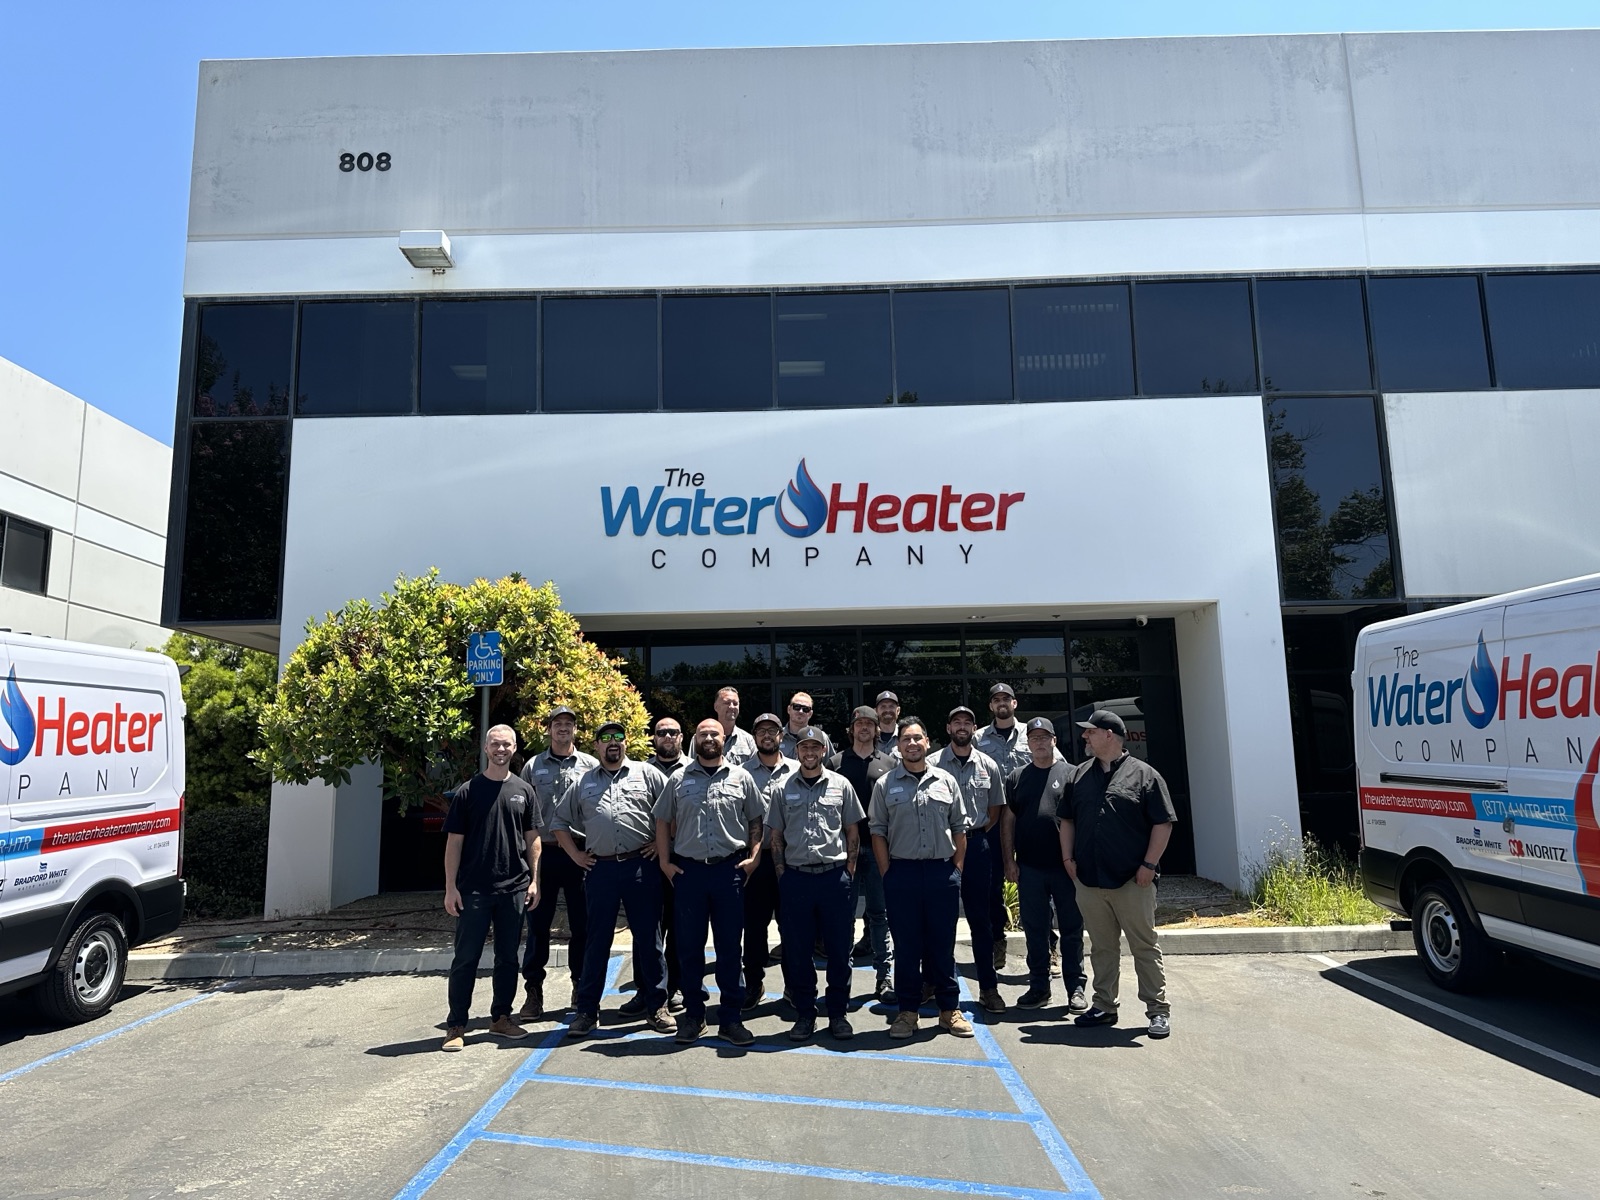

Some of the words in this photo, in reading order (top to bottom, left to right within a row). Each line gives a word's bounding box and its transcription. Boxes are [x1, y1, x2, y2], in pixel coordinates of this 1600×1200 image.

[339, 152, 392, 172] 808
[664, 468, 705, 487] The
[600, 485, 777, 537] Water
[826, 482, 1026, 534] Heater
[651, 543, 974, 569] COMPANY
[469, 659, 501, 670] PARKING
[1394, 645, 1420, 669] The
[475, 671, 494, 682] ONLY
[1367, 672, 1464, 728] Water
[35, 696, 163, 757] Heater
[1364, 793, 1469, 814] thewaterheatercompany.com
[52, 817, 171, 846] thewaterheatercompany.com
[1456, 836, 1484, 847] BRADFORD
[1484, 839, 1502, 850] WHITE
[14, 873, 48, 887] BRADFORD
[48, 868, 68, 879] WHITE
